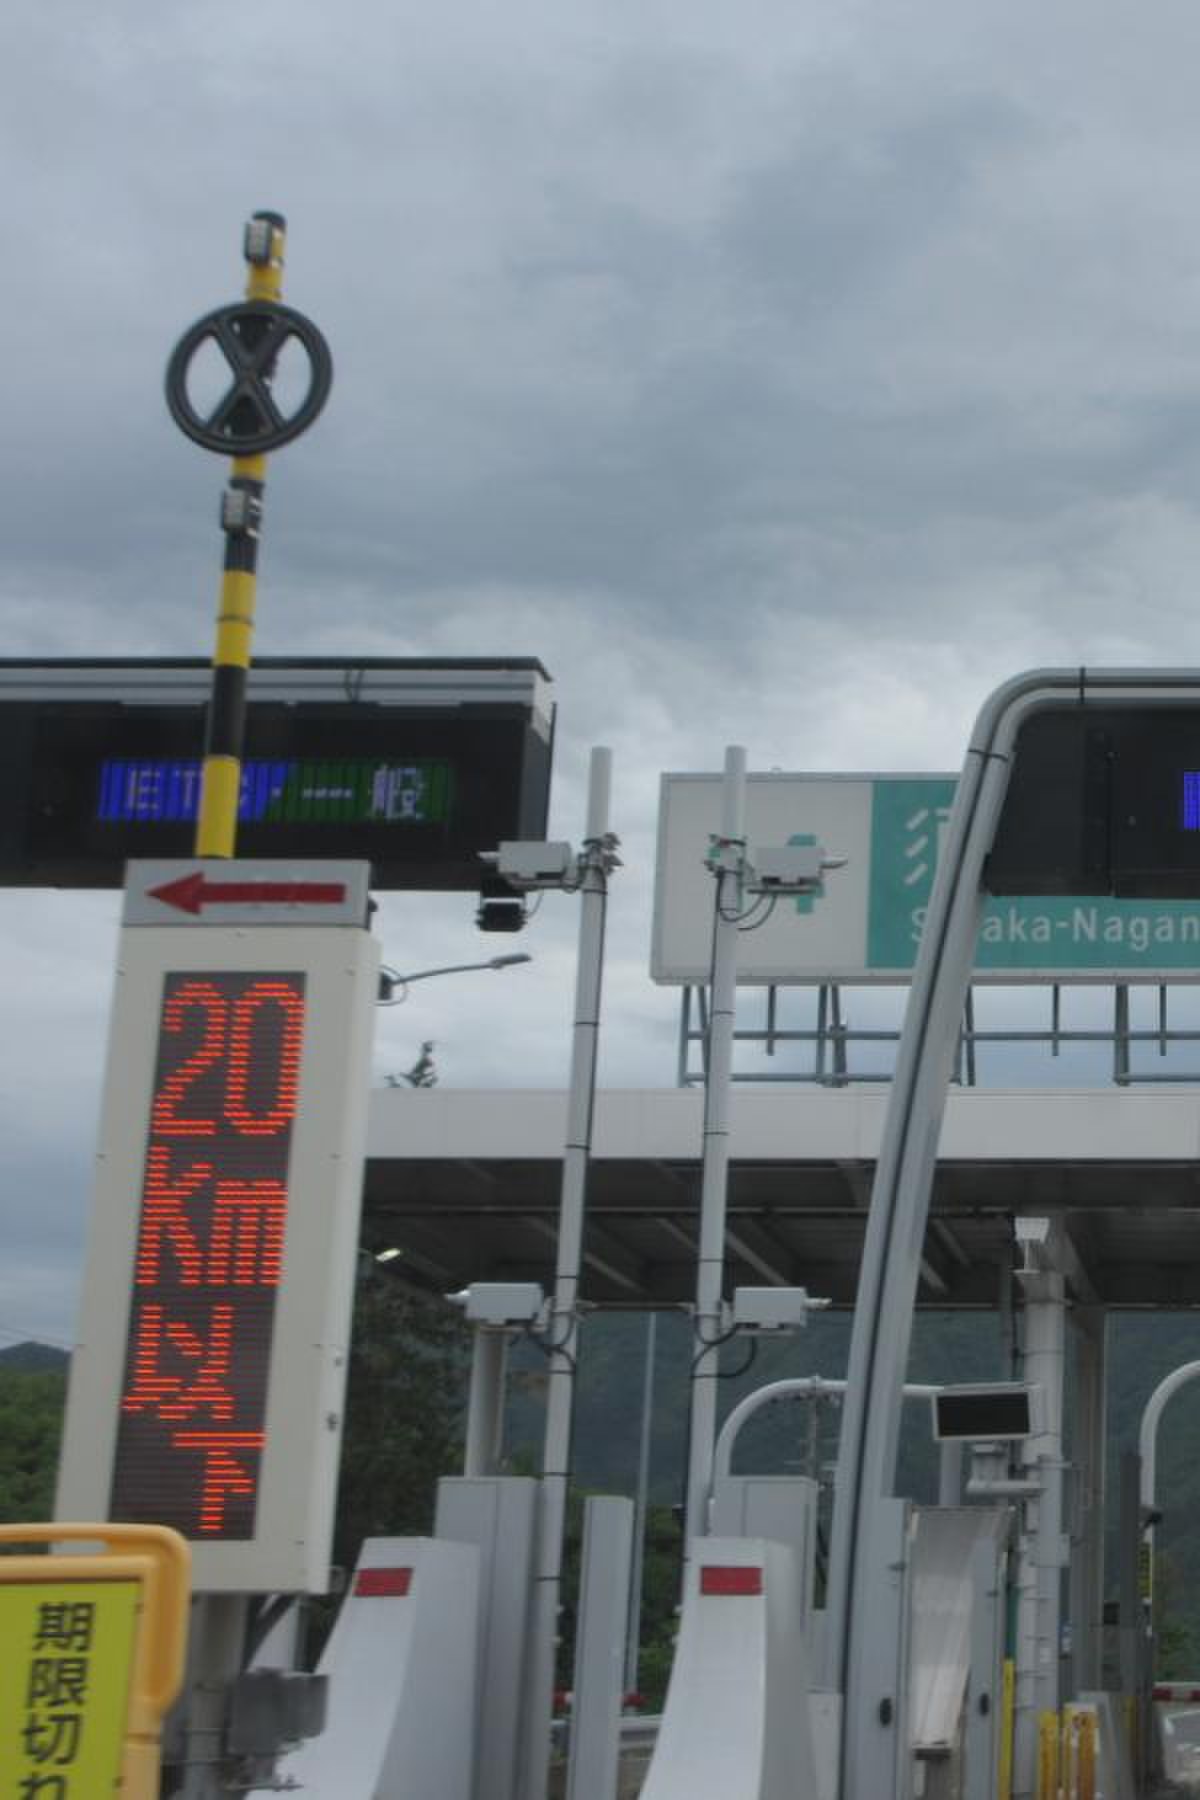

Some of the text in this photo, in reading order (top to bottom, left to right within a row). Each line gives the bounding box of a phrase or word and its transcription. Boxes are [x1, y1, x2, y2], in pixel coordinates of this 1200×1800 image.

[126, 767, 248, 811] ET
[152, 982, 306, 1136] 20
[121, 1304, 268, 1531] 以下
